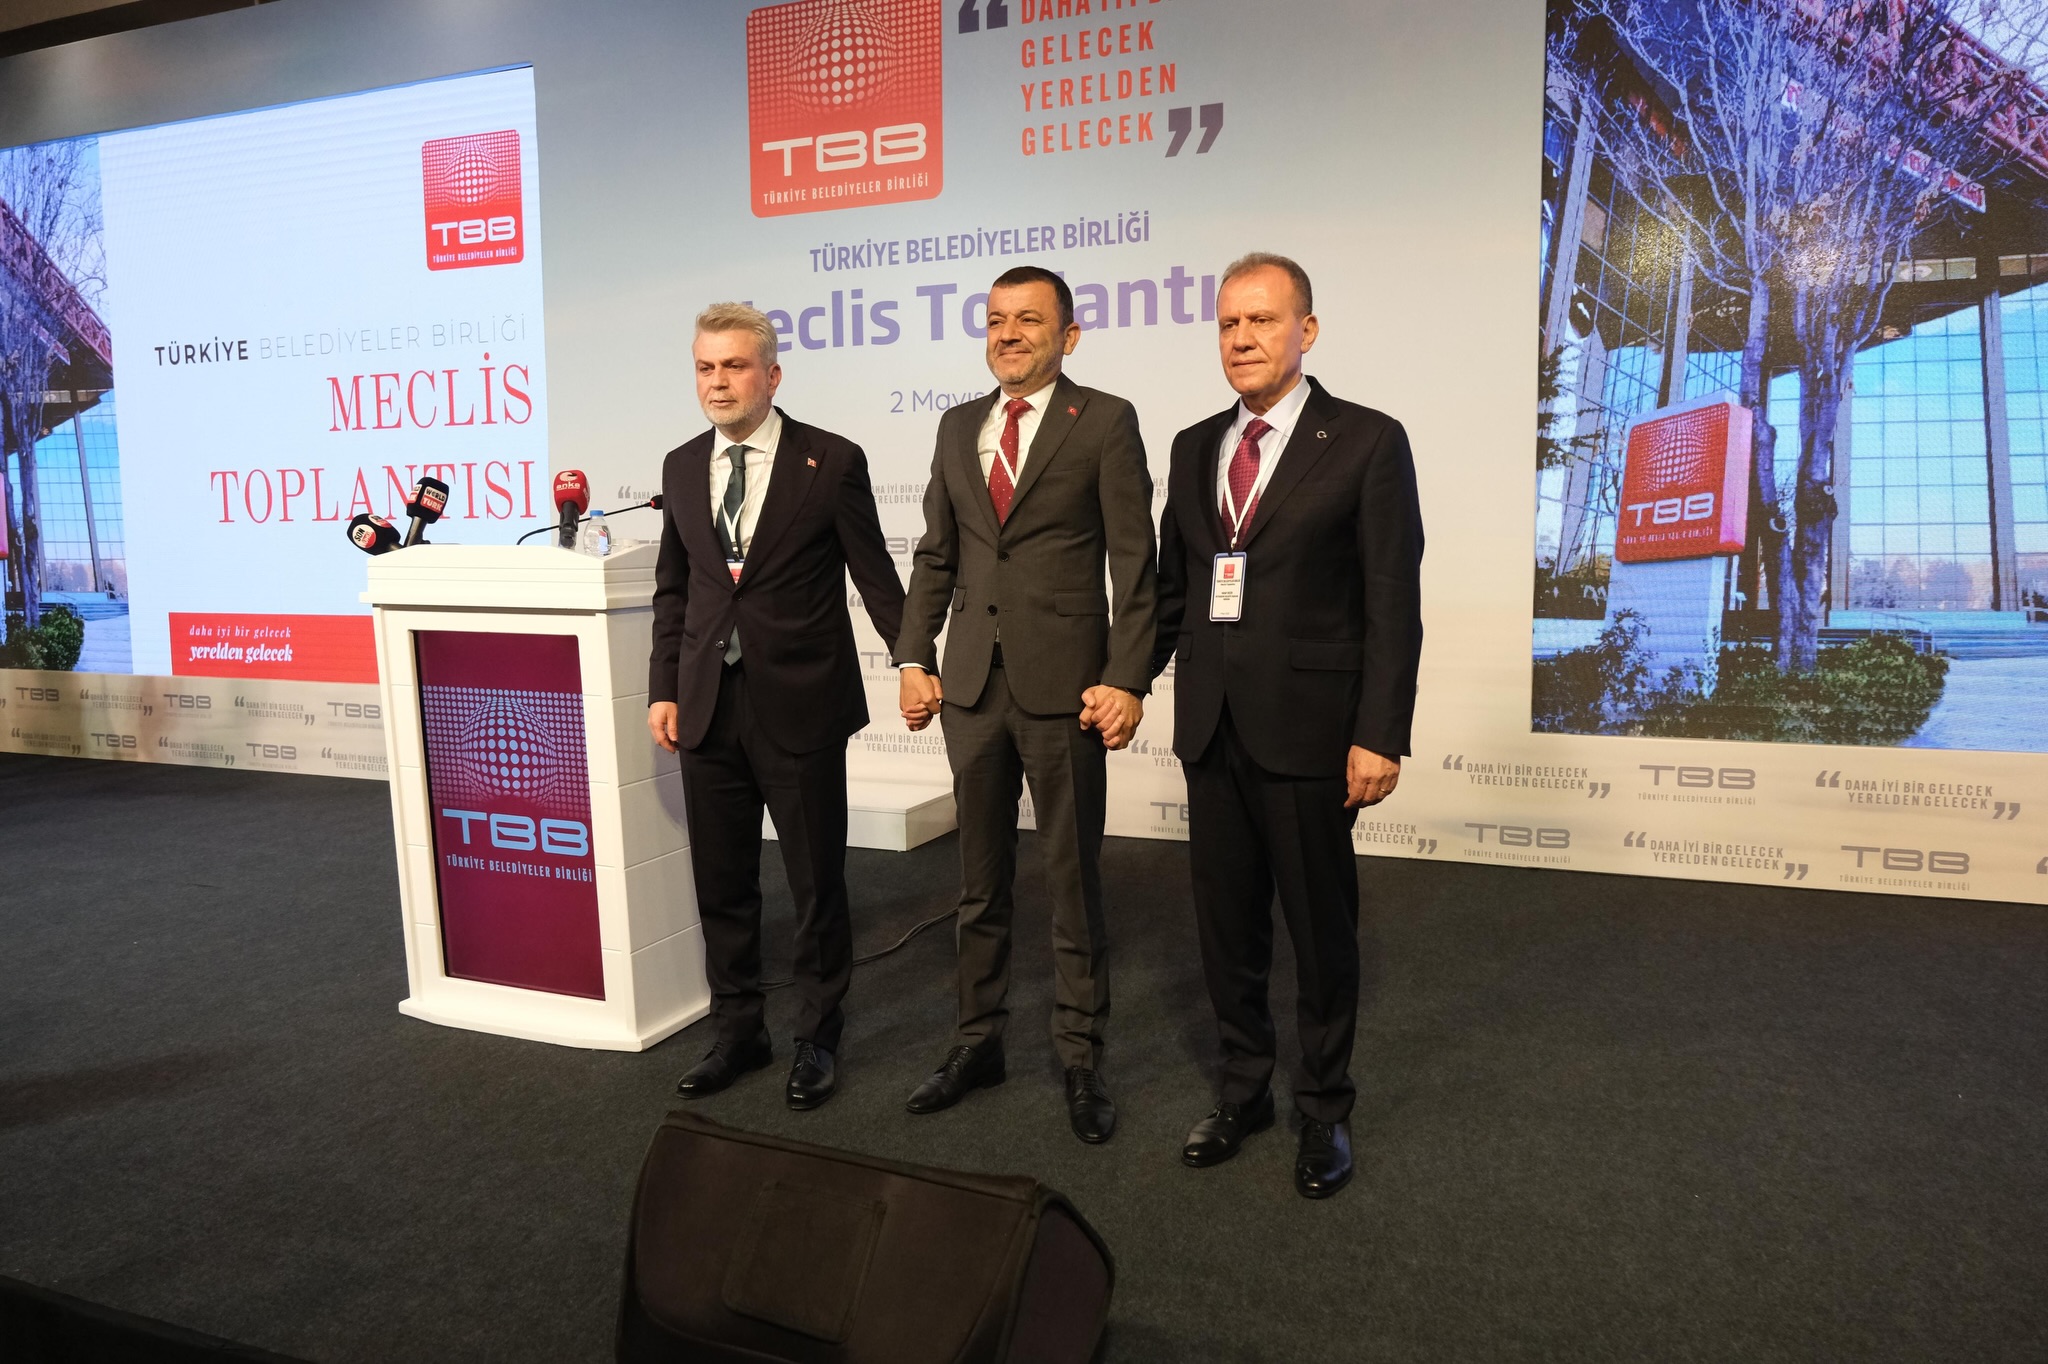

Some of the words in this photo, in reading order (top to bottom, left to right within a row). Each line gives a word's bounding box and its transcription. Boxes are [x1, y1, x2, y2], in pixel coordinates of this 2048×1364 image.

[1021, 20, 1154, 68] GELECEK
[1021, 63, 1176, 112] YERELDEN
[1021, 112, 1153, 156] GELECEK
[762, 122, 927, 177] TBB
[763, 188, 807, 205] TÜRKİYE
[812, 180, 881, 200] BELEDİYELER
[887, 172, 929, 191] BİRLİĞİ
[431, 215, 516, 247] TBB
[810, 238, 900, 273] TÜRKİYE
[906, 226, 1055, 264] BELEDİYELER
[1063, 210, 1150, 250] BİRLİĞİ
[742, 288, 900, 352] eclis
[916, 265, 1216, 341] Toantı
[154, 336, 249, 366] TÜRKİYE
[260, 326, 421, 360] BELEDİYELER
[432, 313, 526, 347] BİRLİĞİ
[326, 352, 533, 432] MECLİS
[890, 391, 904, 413] 2
[210, 460, 538, 524] TOPLANTISI
[425, 488, 446, 502] WORLD
[871, 485, 885, 494] AHA
[875, 494, 911, 504] RELDEN
[1626, 492, 1715, 527] TBB
[189, 624, 213, 636] daha
[217, 625, 231, 638] iyi
[235, 625, 250, 637] bir
[253, 626, 292, 639] gelecek
[188, 642, 244, 662] yerelden
[244, 643, 293, 664] gelecek
[15, 687, 60, 702] TBB
[163, 694, 212, 709] TBB
[326, 702, 381, 719] TBB
[91, 733, 137, 748] TBB
[864, 733, 883, 742] DAHA
[885, 732, 896, 743] İYİ
[898, 733, 911, 744] BİR
[913, 735, 945, 746] GELECE
[866, 743, 909, 754] YERELDEN
[246, 743, 297, 760] TBB
[368, 755, 387, 764] GELEC
[367, 763, 389, 773] GELECE
[1467, 762, 1494, 774] DAHA
[1497, 760, 1511, 775] İYİ
[1515, 761, 1533, 776] BİR
[1535, 764, 1588, 778] GELECEK
[1639, 764, 1756, 790] TBB
[1470, 774, 1529, 788] YERELDEN
[1532, 776, 1584, 789] GELECEK
[1845, 779, 1878, 792] DAHA
[1882, 778, 1899, 793] İYİ
[1903, 780, 1925, 794] BİR
[1929, 783, 1993, 797] GELECEK
[1848, 792, 1920, 806] YERELDEN
[1924, 796, 1988, 810] GELECEK
[442, 808, 589, 856] TBB
[1369, 821, 1417, 835] GELECEK
[1464, 822, 1571, 849] TBB
[1366, 832, 1413, 845] GELECEK
[1651, 840, 1680, 852] DAHA
[1683, 839, 1699, 853] İYİ
[1703, 841, 1722, 854] BİR
[1725, 845, 1784, 859] GELECEK
[446, 854, 485, 870] TÜRKİYE
[489, 860, 551, 878] BELEDİYELER
[555, 866, 593, 883] BİRLİĞİ
[1653, 852, 1718, 866] YERELDEN
[1721, 855, 1779, 870] GELECEK
[1840, 845, 1970, 874] TBB
